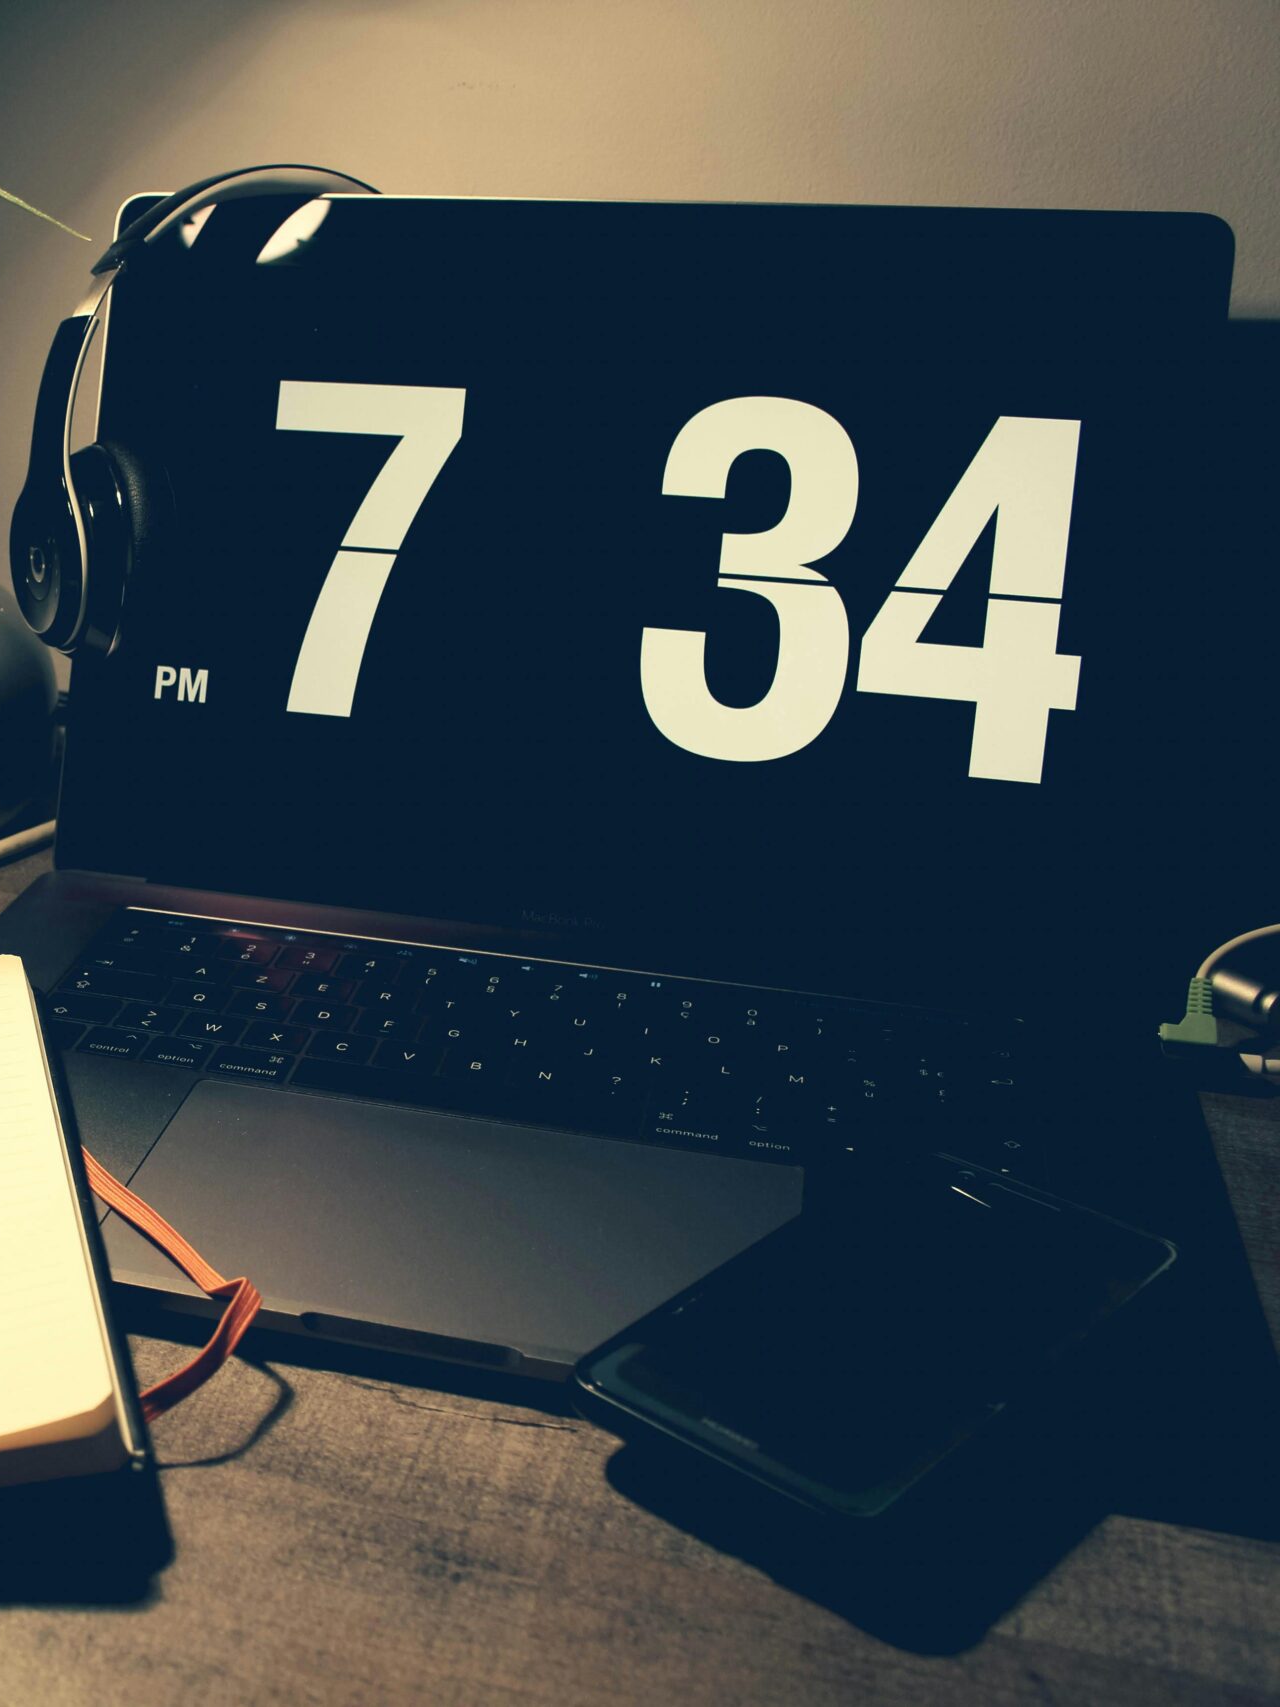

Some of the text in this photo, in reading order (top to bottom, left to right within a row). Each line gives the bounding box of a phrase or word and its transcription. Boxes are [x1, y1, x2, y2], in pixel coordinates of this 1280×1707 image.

[275, 380, 1082, 785] 7 34
[153, 664, 210, 705] PM
[88, 1042, 130, 1054] control
[157, 1053, 195, 1065] option
[219, 1063, 278, 1077] command
[655, 1126, 719, 1141] command
[748, 1140, 791, 1151] option
